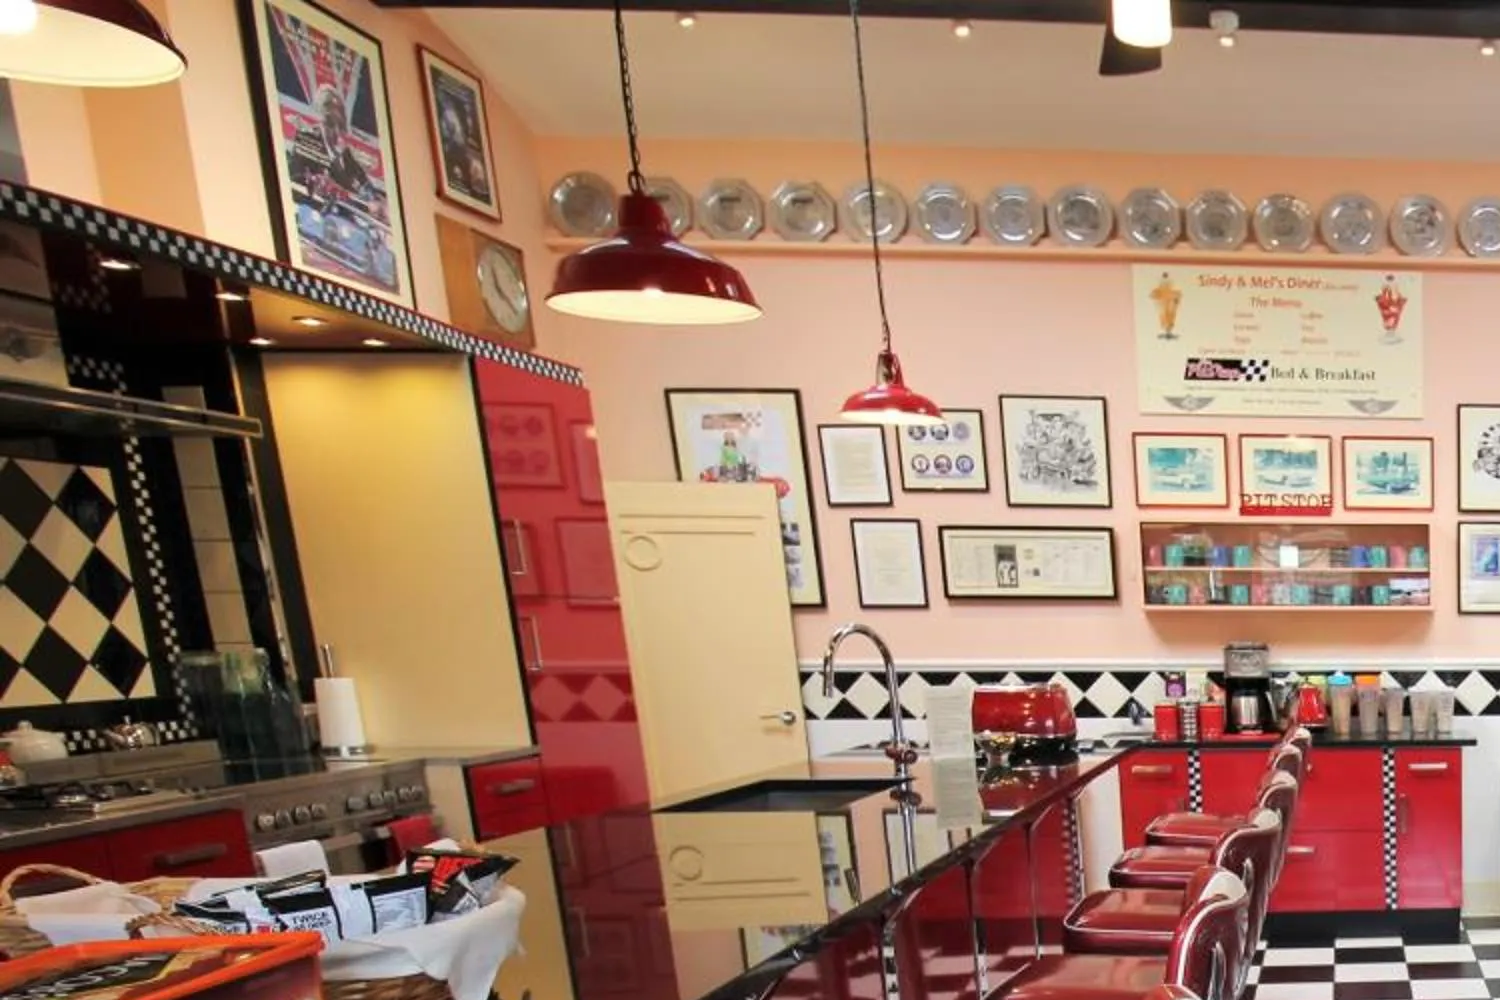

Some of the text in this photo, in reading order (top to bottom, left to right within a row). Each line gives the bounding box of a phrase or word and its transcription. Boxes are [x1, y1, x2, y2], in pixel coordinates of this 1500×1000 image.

[1250, 276, 1283, 289] Mel's
[1287, 277, 1321, 289] Diner
[1271, 367, 1376, 381] Bed & Breakfast
